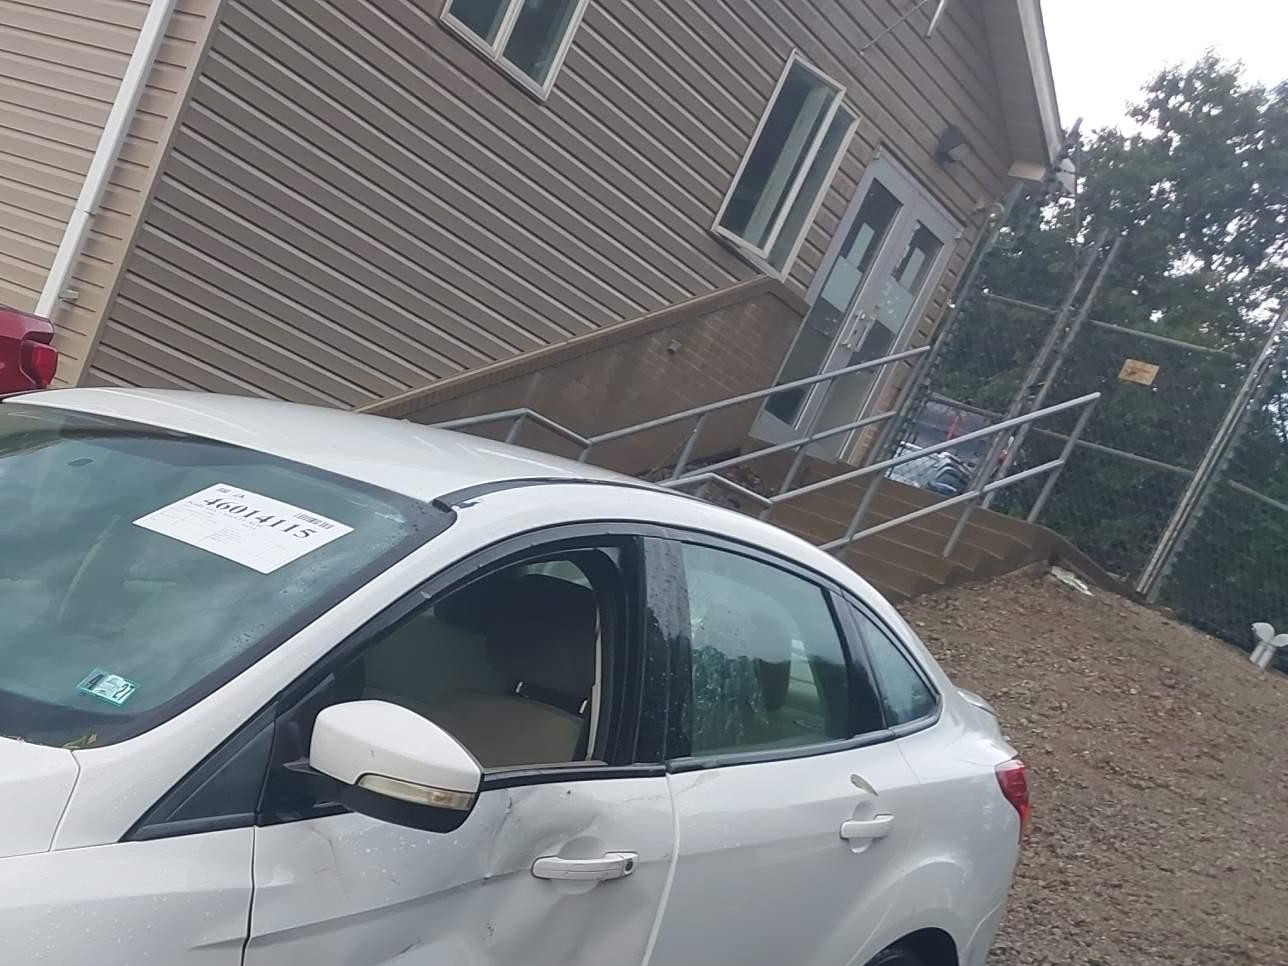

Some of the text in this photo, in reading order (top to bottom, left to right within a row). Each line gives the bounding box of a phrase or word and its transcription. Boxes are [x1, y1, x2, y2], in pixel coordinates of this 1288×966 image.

[202, 497, 317, 540] 46014115
[87, 674, 104, 691] 4
[112, 683, 135, 701] 27
